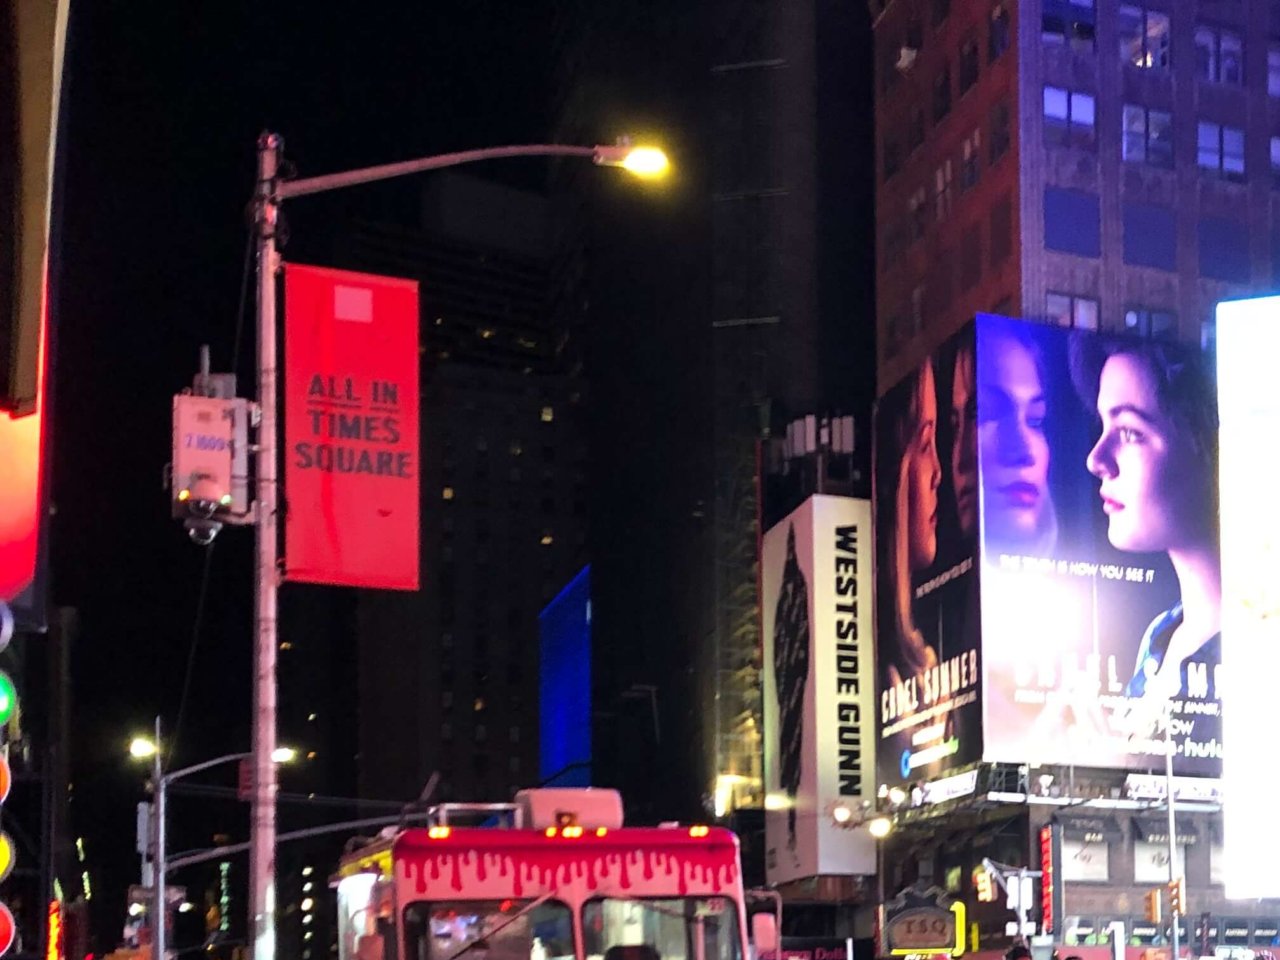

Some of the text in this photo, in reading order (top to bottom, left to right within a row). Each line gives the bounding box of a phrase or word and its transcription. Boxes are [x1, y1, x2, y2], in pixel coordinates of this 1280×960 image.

[307, 373, 398, 405] ALL IN
[307, 409, 400, 444] TIMES
[295, 442, 413, 479] SQUARE
[1070, 562, 1100, 577] HOW
[1100, 564, 1125, 581] YOU
[1126, 567, 1144, 583] SEE
[1145, 570, 1155, 584] IT
[834, 524, 862, 797] WESTSIDE GUNN
[881, 675, 919, 724] CRUEL
[923, 648, 978, 705] SUMMER
